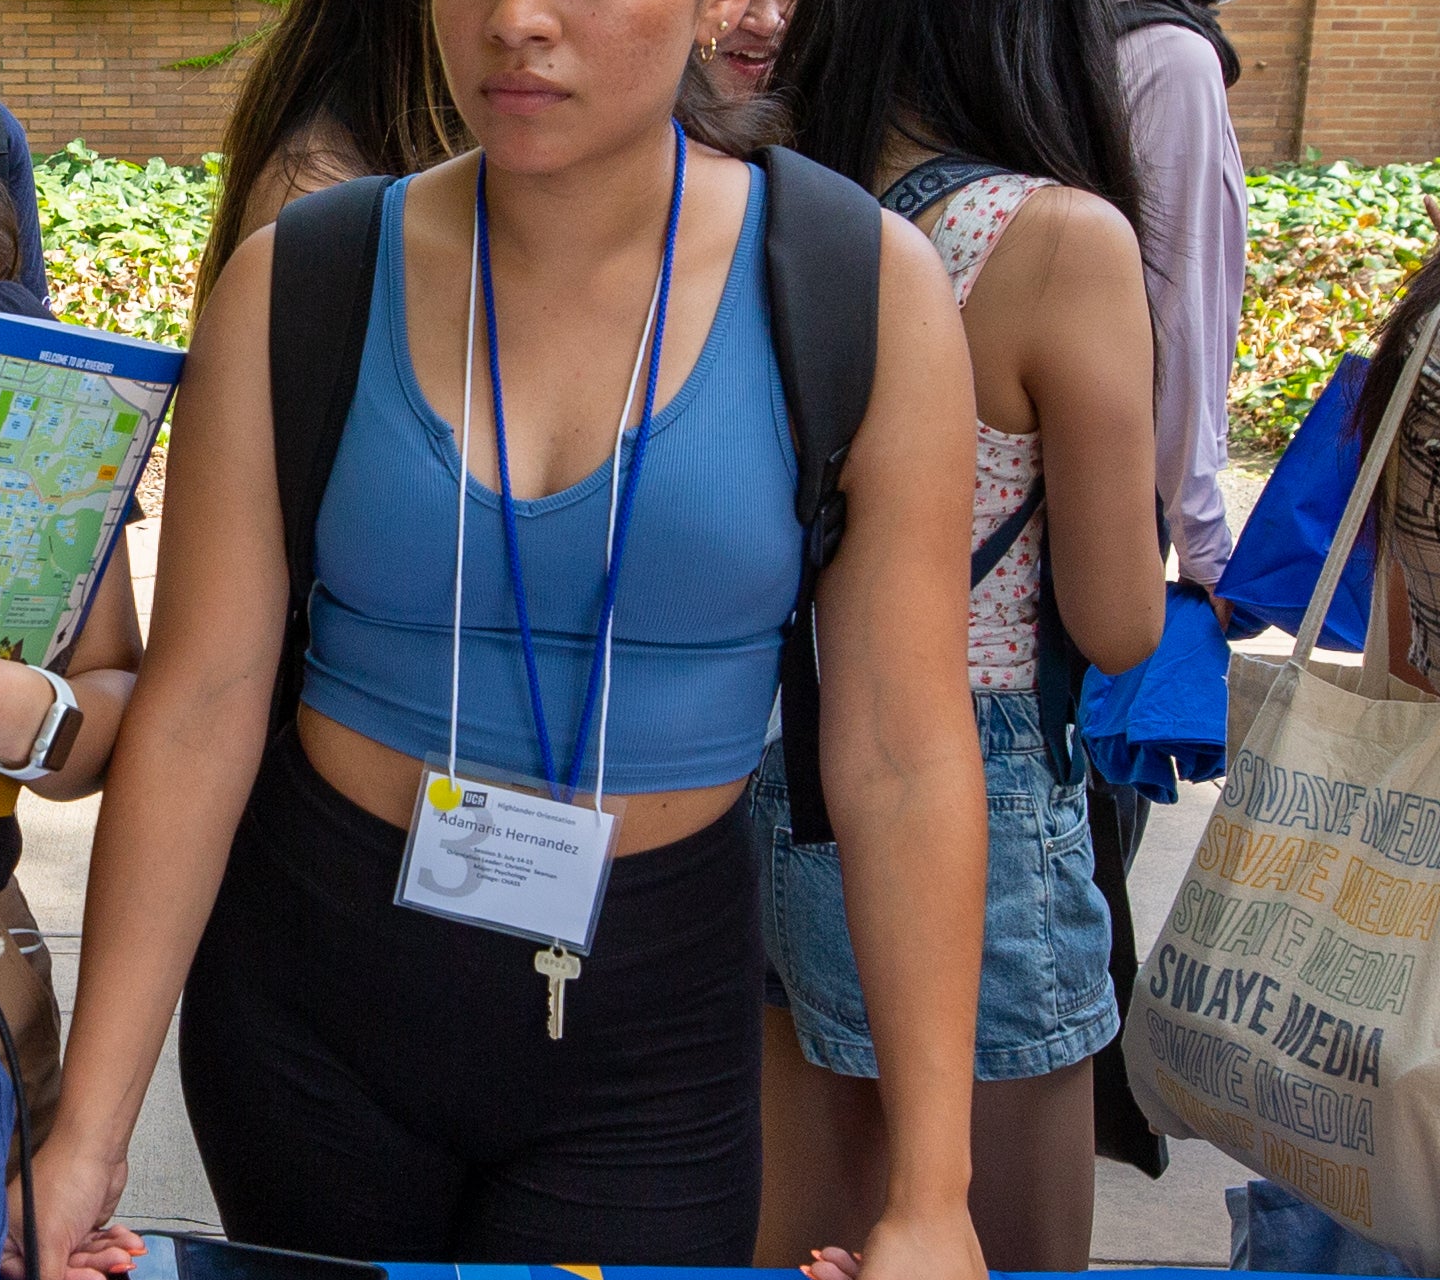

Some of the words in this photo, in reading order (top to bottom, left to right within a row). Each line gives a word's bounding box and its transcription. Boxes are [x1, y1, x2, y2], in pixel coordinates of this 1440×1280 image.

[464, 793, 486, 806] UCR
[497, 802, 536, 817] Highlander
[536, 810, 576, 826] Orientation
[1224, 749, 1366, 835] SWAYE
[438, 812, 502, 837] Adamaris
[505, 827, 580, 855] Hernandez
[446, 849, 481, 862] Orientation
[504, 853, 516, 863] July
[1198, 815, 1339, 903] SWAYE
[494, 867, 528, 881] Psychology
[1174, 880, 1313, 968] SWAYE
[1299, 926, 1416, 1016] MEDIA
[1150, 943, 1280, 1036] SWAYE
[1272, 992, 1384, 1087] MEDIA
[1146, 1007, 1251, 1109] SWAYE
[1255, 1059, 1375, 1156] MEDIA
[1262, 1131, 1372, 1227] MEDIA
